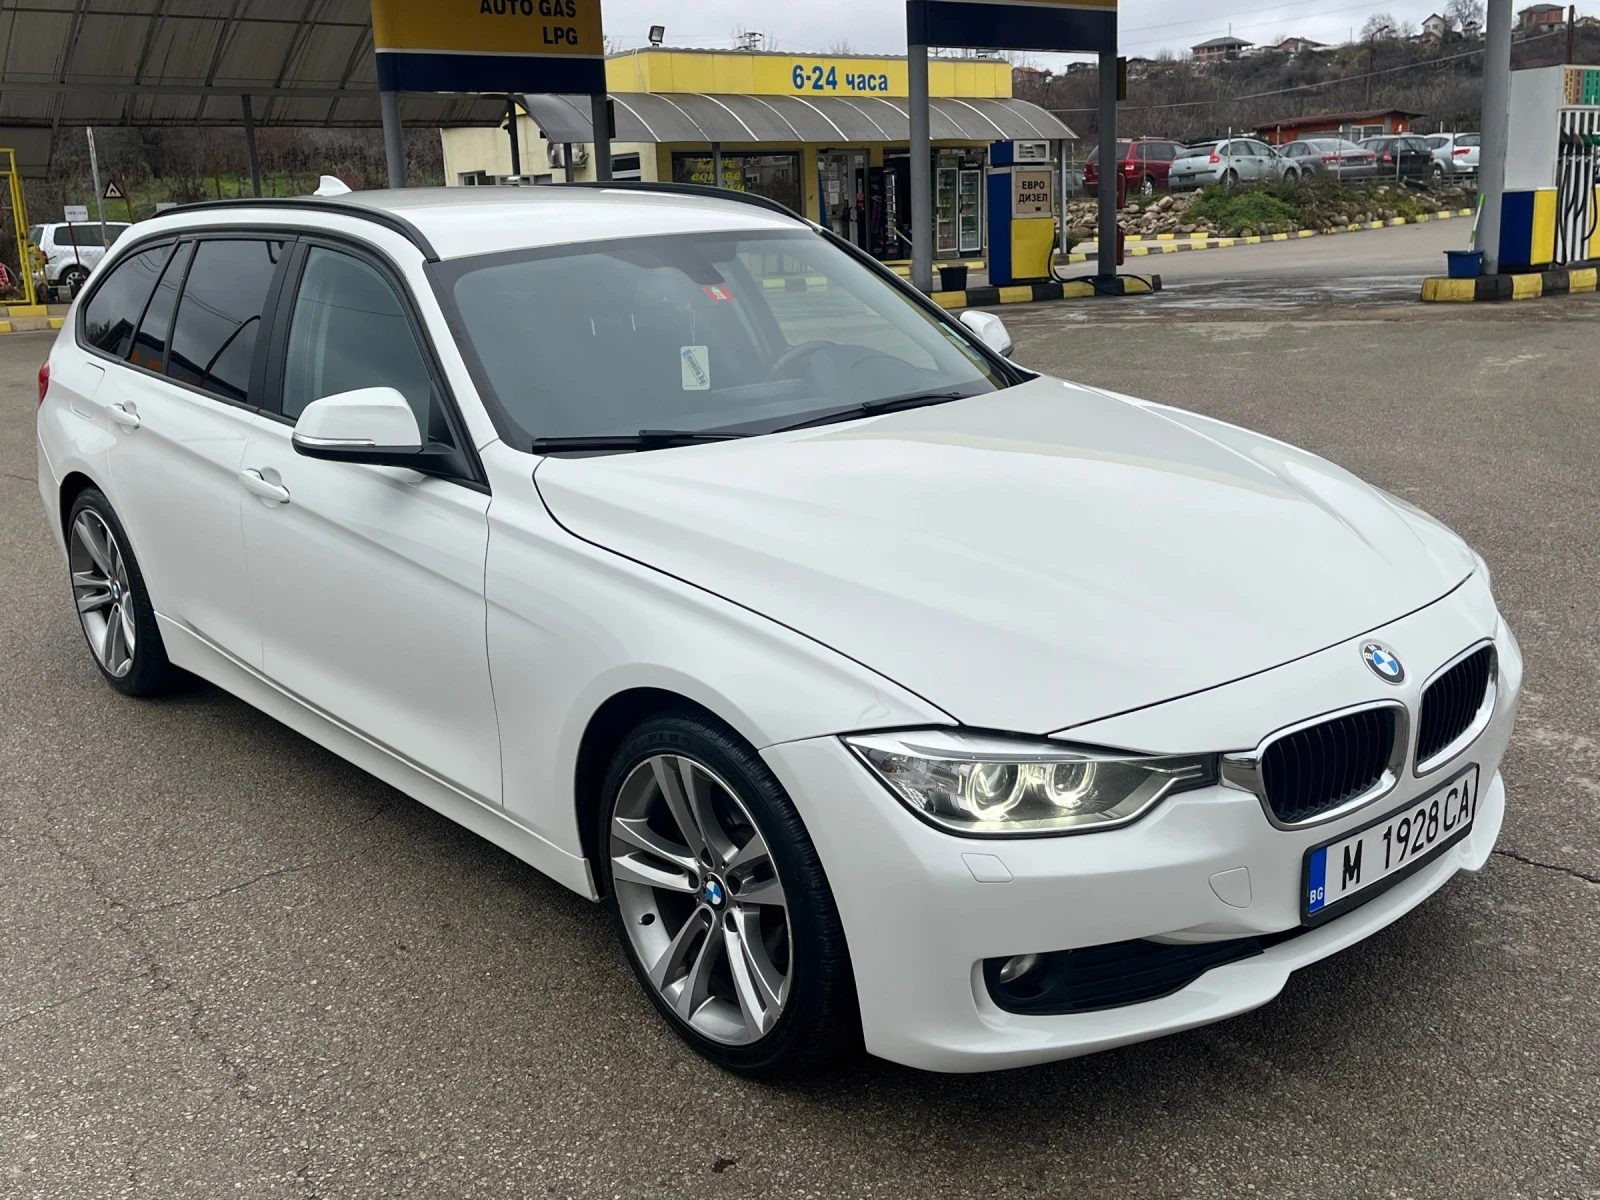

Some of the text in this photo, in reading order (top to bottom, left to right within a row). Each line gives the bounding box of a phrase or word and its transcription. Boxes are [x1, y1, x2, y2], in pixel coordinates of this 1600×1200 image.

[480, 0, 577, 18] AUTO GAS
[543, 26, 578, 46] LPG
[792, 64, 888, 91] 6-24 часа
[1021, 181, 1045, 190] ЕВРО
[1018, 193, 1048, 204] ДИЗЕЛ
[1342, 780, 1469, 891] M 1928 CA
[1309, 886, 1324, 905] BG
